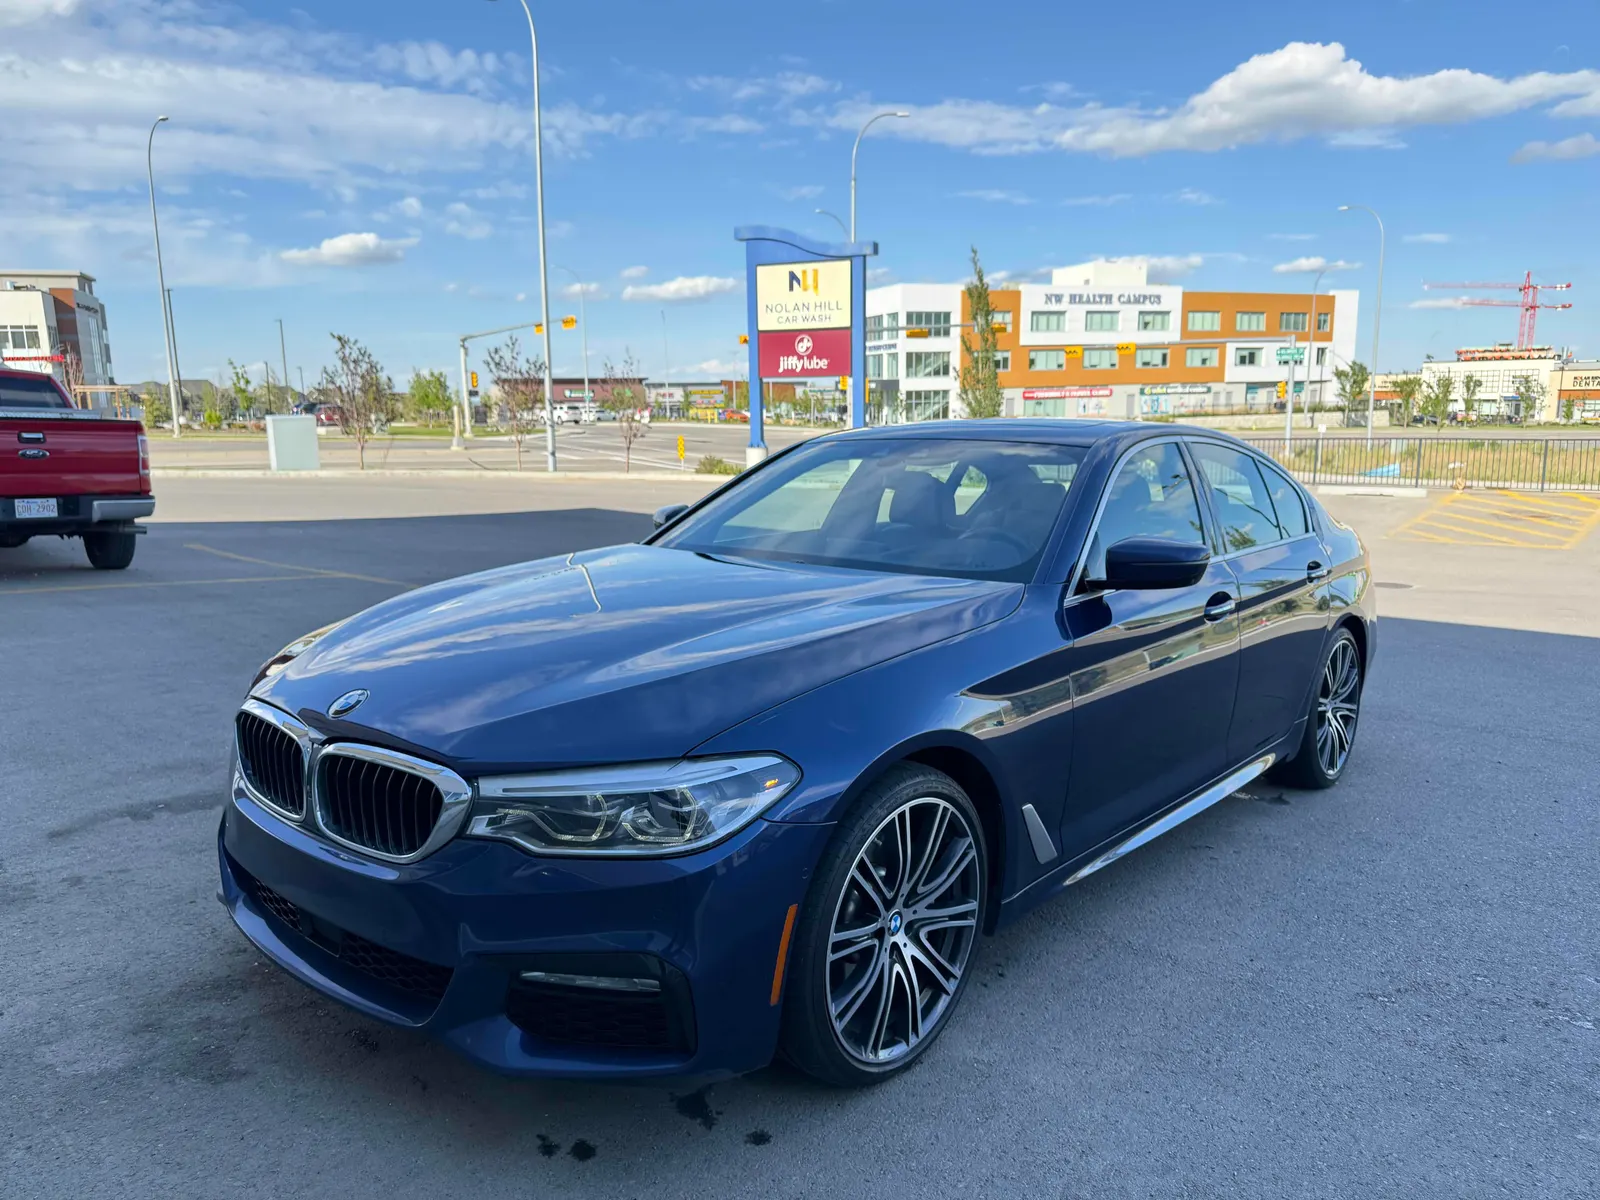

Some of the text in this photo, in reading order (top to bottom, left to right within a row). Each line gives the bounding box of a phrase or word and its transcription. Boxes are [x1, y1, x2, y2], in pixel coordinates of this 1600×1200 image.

[1044, 293, 1162, 305] NW HEALTH CAMPUS
[765, 300, 843, 314] NOLAN HILL
[776, 314, 832, 325] CAR WASH
[778, 355, 828, 373] jiffy lube
